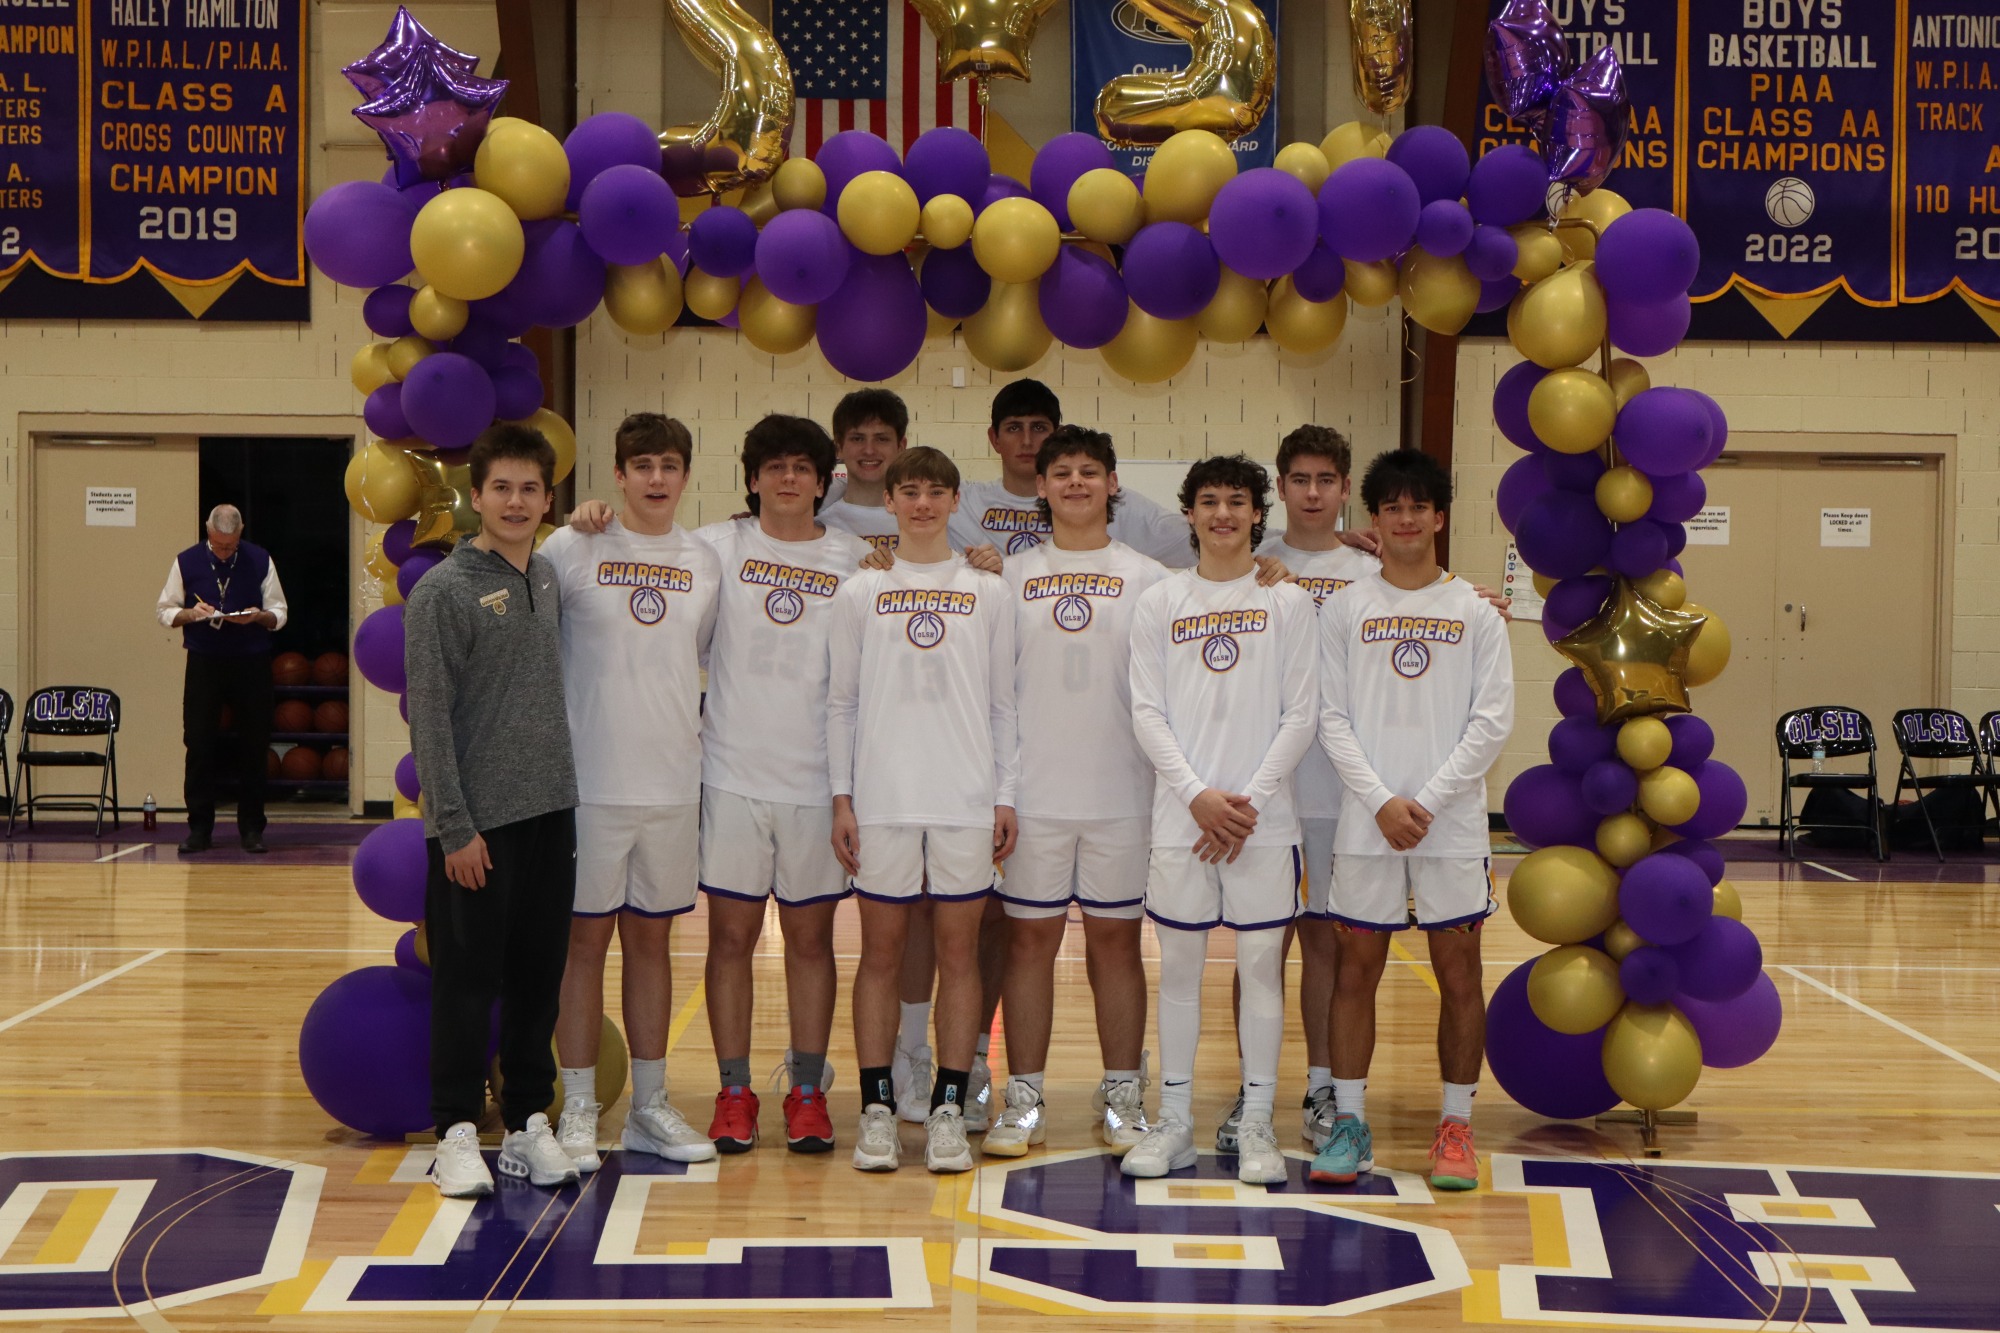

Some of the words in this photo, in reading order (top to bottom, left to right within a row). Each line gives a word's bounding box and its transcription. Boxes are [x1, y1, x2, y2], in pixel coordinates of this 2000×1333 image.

[112, 0, 170, 27] HALEY
[186, 0, 278, 29] HAMILTON
[1552, 0, 1625, 26] OYS
[1743, 0, 1842, 29] BOYS
[1709, 34, 1876, 68] BASKETBALL
[102, 81, 232, 111] CLASS
[265, 84, 287, 113] A
[1751, 73, 1833, 102] PIAA
[1704, 107, 1812, 136] CLASS
[1840, 109, 1880, 138] AA
[1916, 102, 1983, 131] TRACK
[102, 122, 171, 152] CROSS
[188, 125, 286, 154] COUNTRY
[1697, 140, 1885, 171] CHAMPIONS
[111, 163, 277, 195] CHAMPION
[1916, 185, 1949, 213] 110
[140, 206, 237, 240] 2019
[2, 227, 20, 255] 2
[1745, 234, 1832, 262] 2022
[982, 508, 1053, 533] CHARGE
[598, 561, 692, 592] CHARGERS
[740, 559, 838, 597] CHARGERS
[1024, 573, 1123, 601] CHARGERS
[877, 590, 976, 615] CHARGERS
[1172, 609, 1268, 644] CHARGERS
[1362, 616, 1465, 645] CHARGERS
[35, 691, 110, 720] OLSH
[1787, 711, 1861, 745] OLSH
[1902, 713, 1970, 744] OLSH
